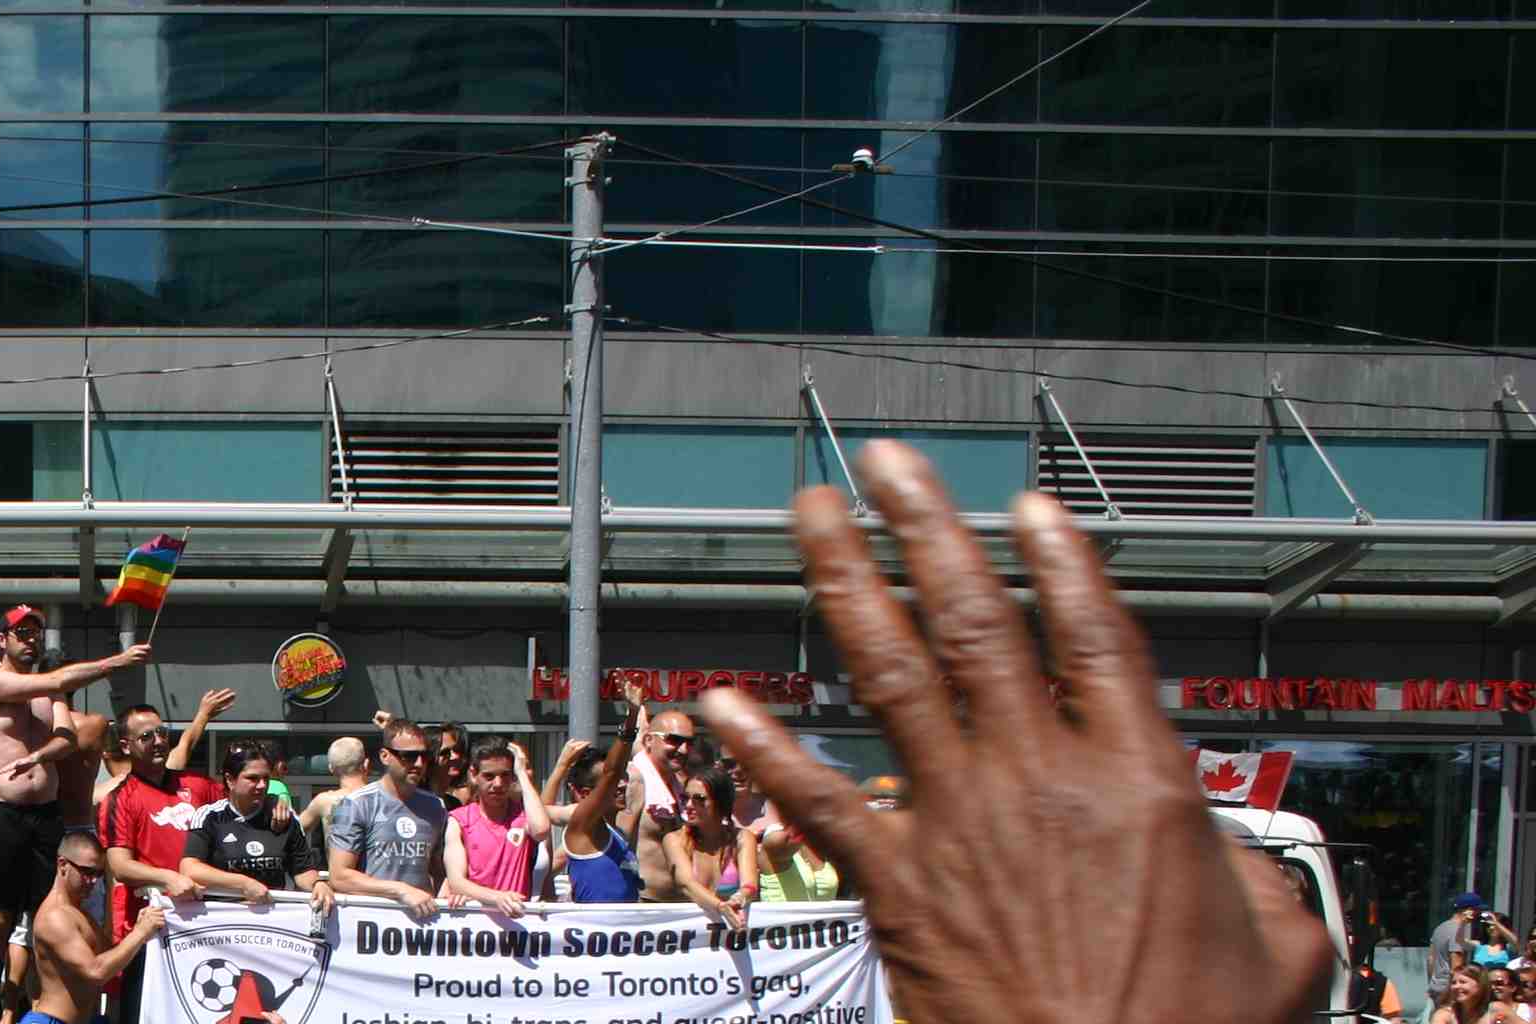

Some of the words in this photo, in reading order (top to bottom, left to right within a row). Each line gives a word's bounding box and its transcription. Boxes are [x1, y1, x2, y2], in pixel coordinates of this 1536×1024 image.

[532, 668, 815, 705] HMBURGERS
[1181, 677, 1377, 710] FOUNTAIN
[1401, 679, 1536, 714] MALTS
[375, 840, 432, 858] KAISER
[174, 936, 232, 953] DOWNTOWN
[234, 935, 272, 946] SOCCER
[276, 938, 320, 958] TORONTO
[357, 920, 552, 958] Downtown
[563, 926, 697, 958] Soccer
[707, 919, 861, 952] Toronto:
[414, 972, 501, 998] Proud
[512, 976, 543, 998] to
[554, 972, 590, 998] be
[601, 970, 741, 998] Toronto's
[751, 973, 811, 1000] gay,
